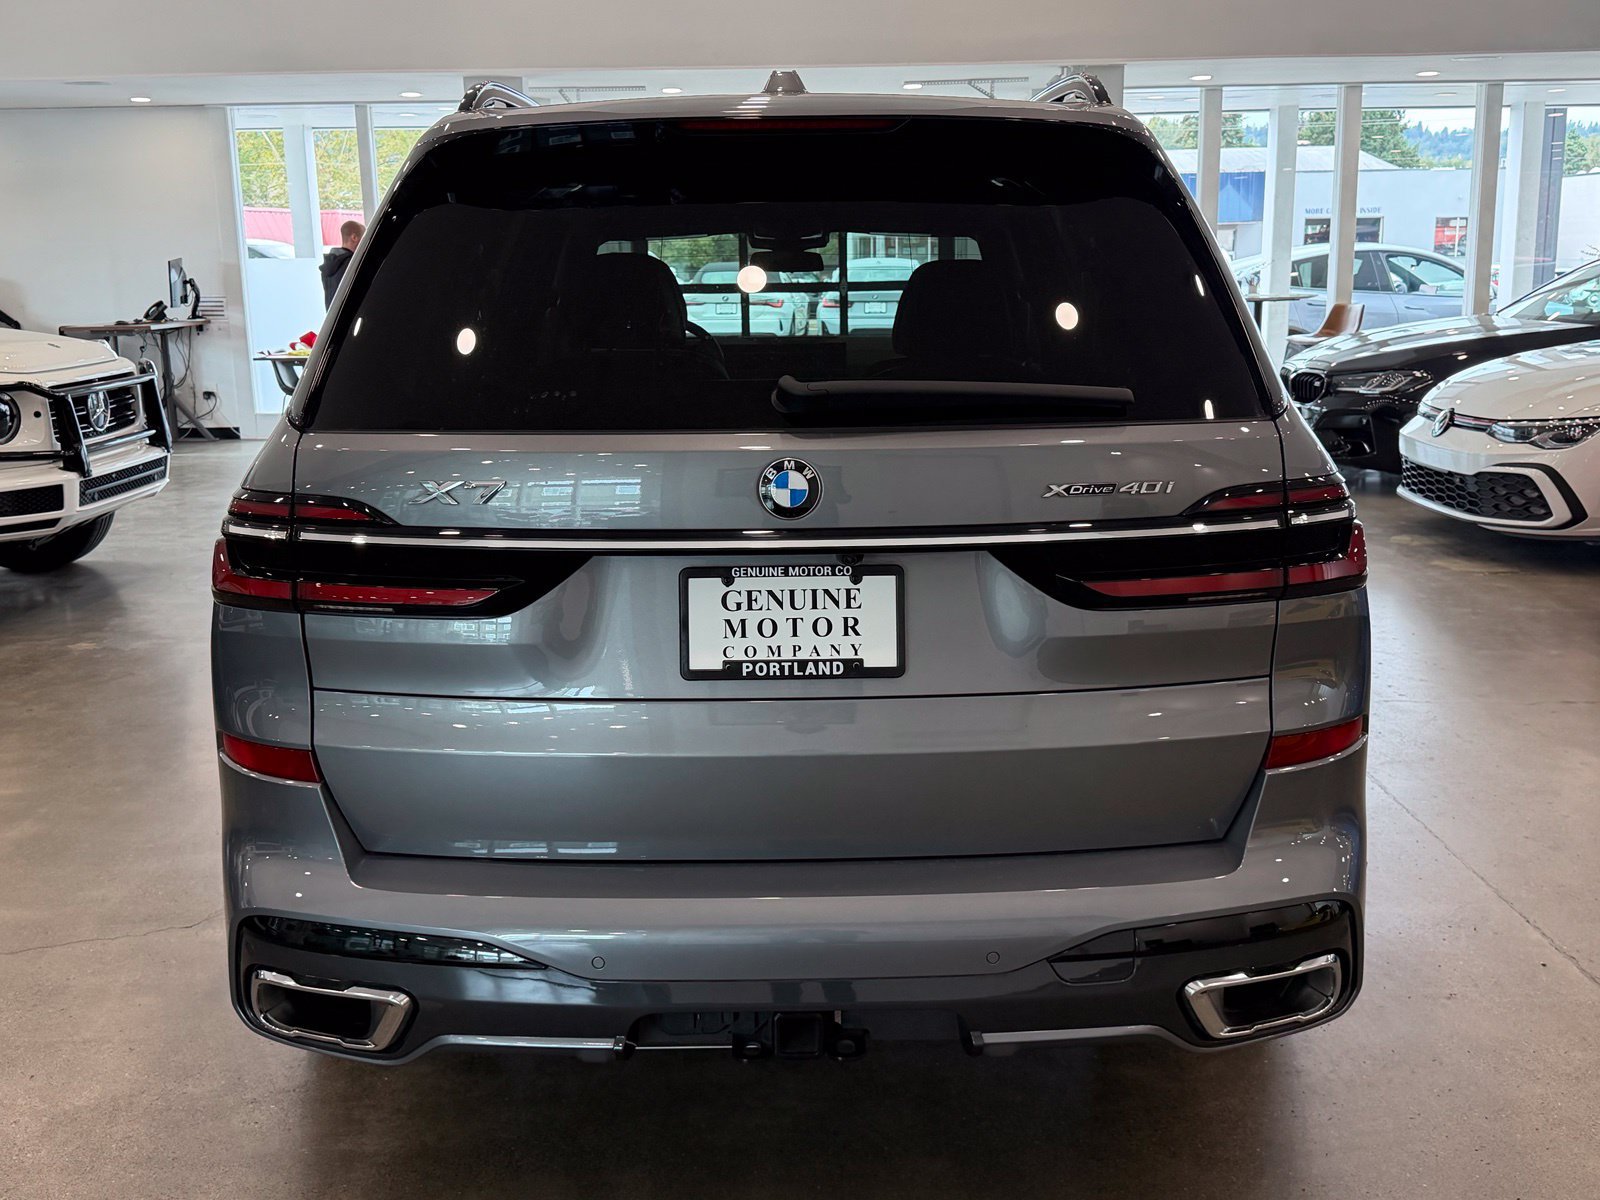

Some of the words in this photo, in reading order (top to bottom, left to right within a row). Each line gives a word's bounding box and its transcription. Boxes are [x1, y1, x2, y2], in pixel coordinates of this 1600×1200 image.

[1305, 207, 1324, 215] MORE
[765, 460, 815, 480] BMW
[408, 480, 507, 505] X7
[731, 567, 785, 578] GENUINE
[788, 566, 832, 577] MOTOR
[835, 565, 852, 576] CO
[720, 587, 863, 612] GENUINE
[722, 616, 863, 639] MOTOR
[722, 643, 863, 659] COMPANY
[742, 661, 844, 677] PORTLAND
